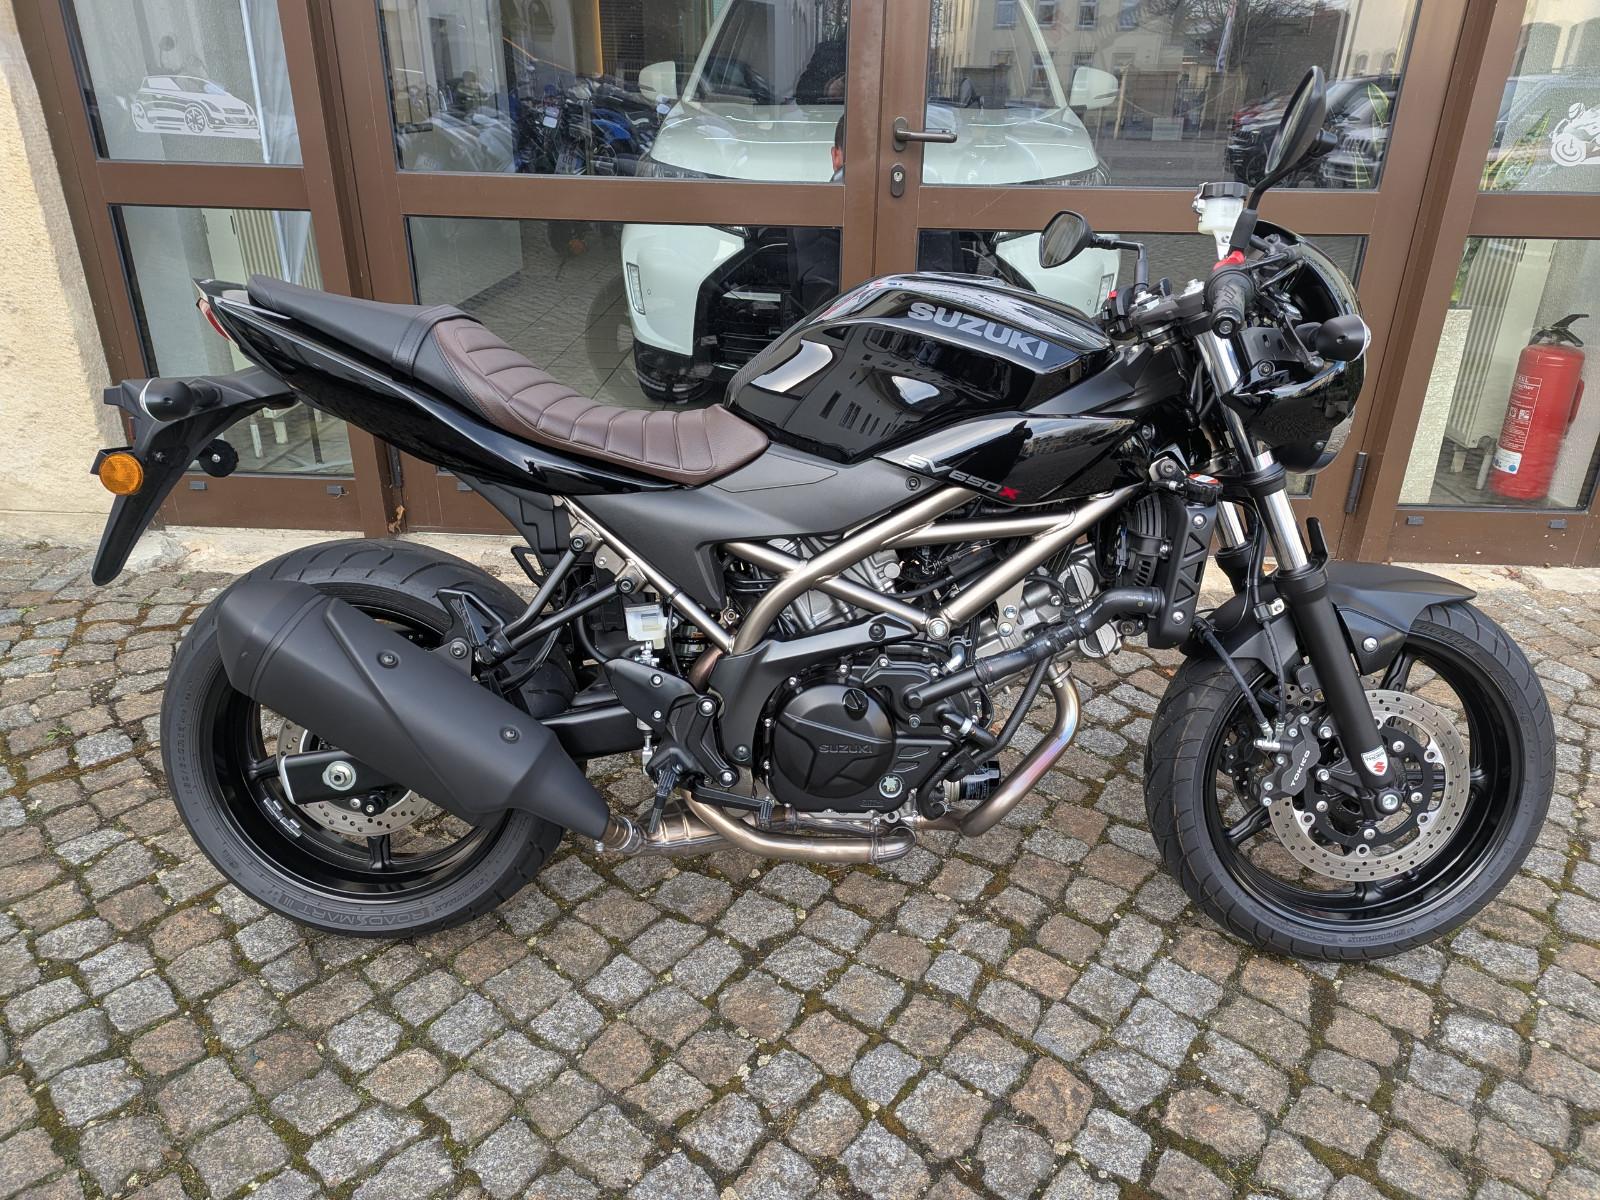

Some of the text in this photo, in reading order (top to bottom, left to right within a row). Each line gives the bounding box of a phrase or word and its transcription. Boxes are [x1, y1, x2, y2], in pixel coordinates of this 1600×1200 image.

[907, 302, 1049, 360] SUZUKI
[818, 744, 873, 754] SUZUKI
[1290, 750, 1310, 787] TOKICO
